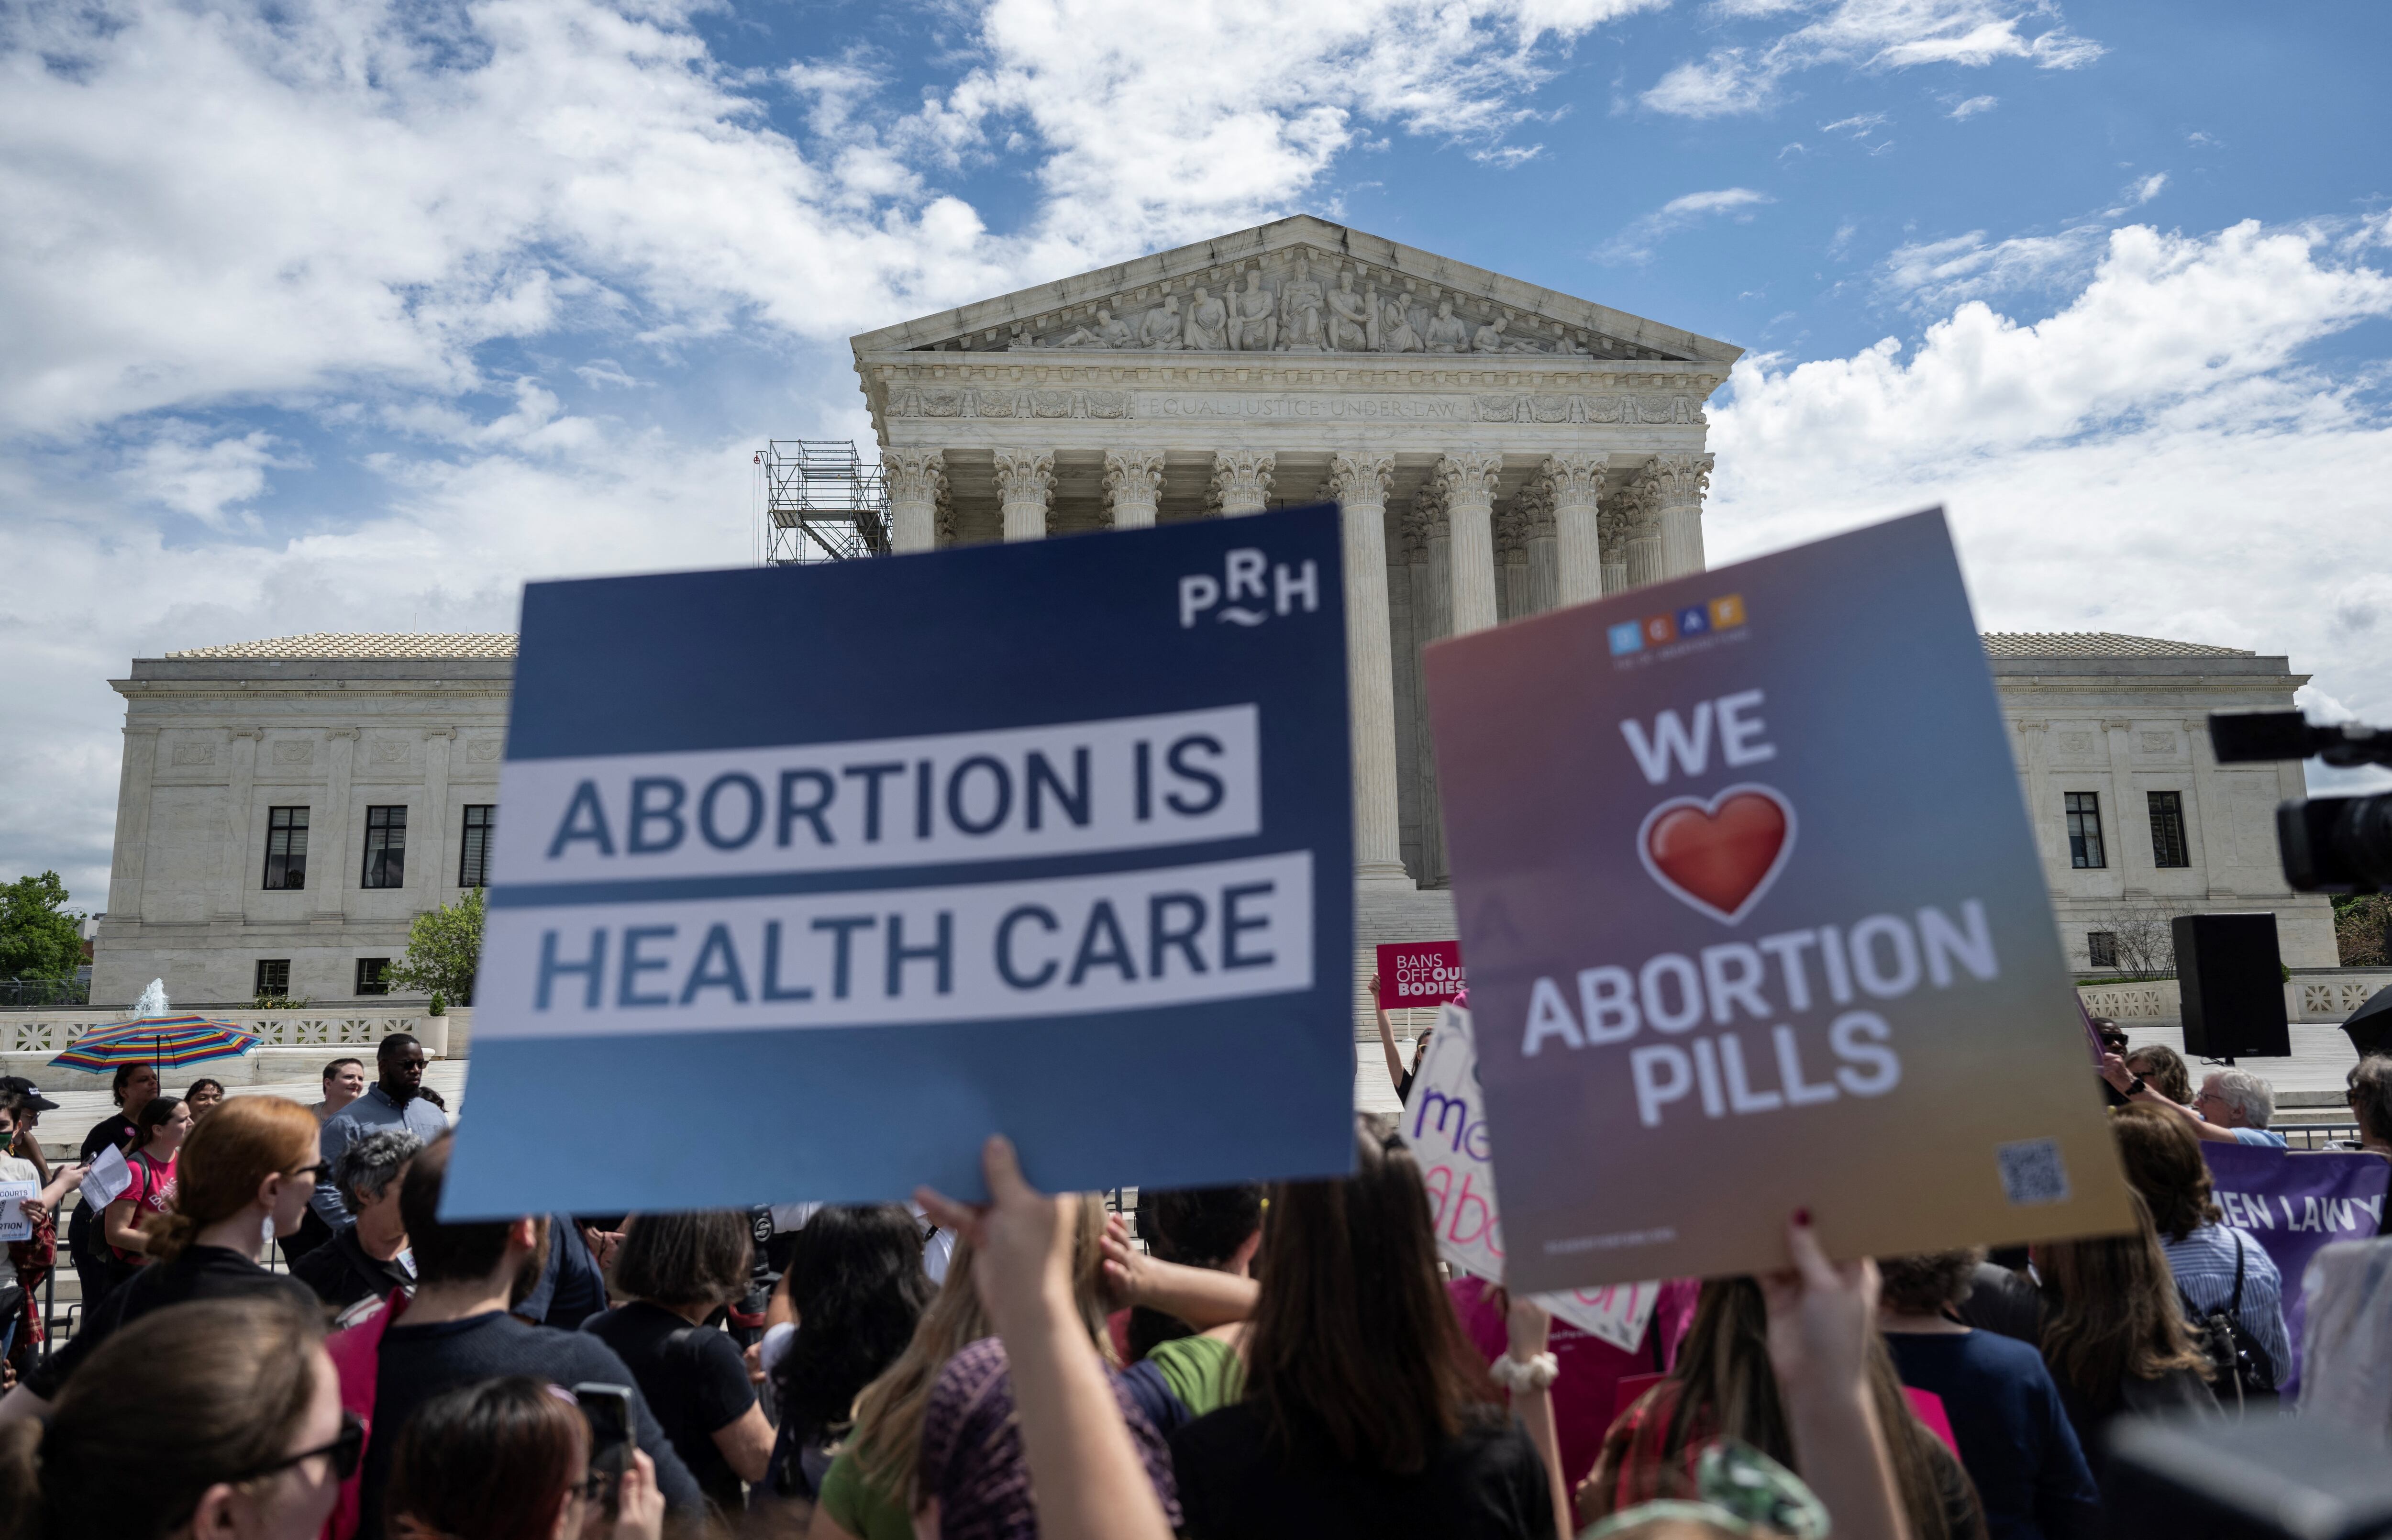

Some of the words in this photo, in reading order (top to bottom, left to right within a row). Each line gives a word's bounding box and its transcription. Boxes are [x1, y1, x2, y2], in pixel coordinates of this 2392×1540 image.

[1150, 399, 1227, 416] EQUAL
[1231, 399, 1319, 416] JUSTICE
[1331, 400, 1405, 416] UNDER
[1414, 401, 1456, 417] LAW
[1180, 549, 1319, 627] PRH
[1621, 690, 1776, 783] WE
[548, 746, 1092, 858] ABORTION
[1134, 733, 1226, 822] IS
[532, 911, 953, 1011] HEALTH
[994, 880, 1276, 991] CARE
[1396, 953, 1442, 969] BANS
[1396, 968, 1430, 982] OFF
[1522, 899, 1998, 1056] ABORTION
[1398, 980, 1467, 996] BODIES
[1630, 1012, 1900, 1127] PILLS
[2279, 1194, 2387, 1232] LAWY
